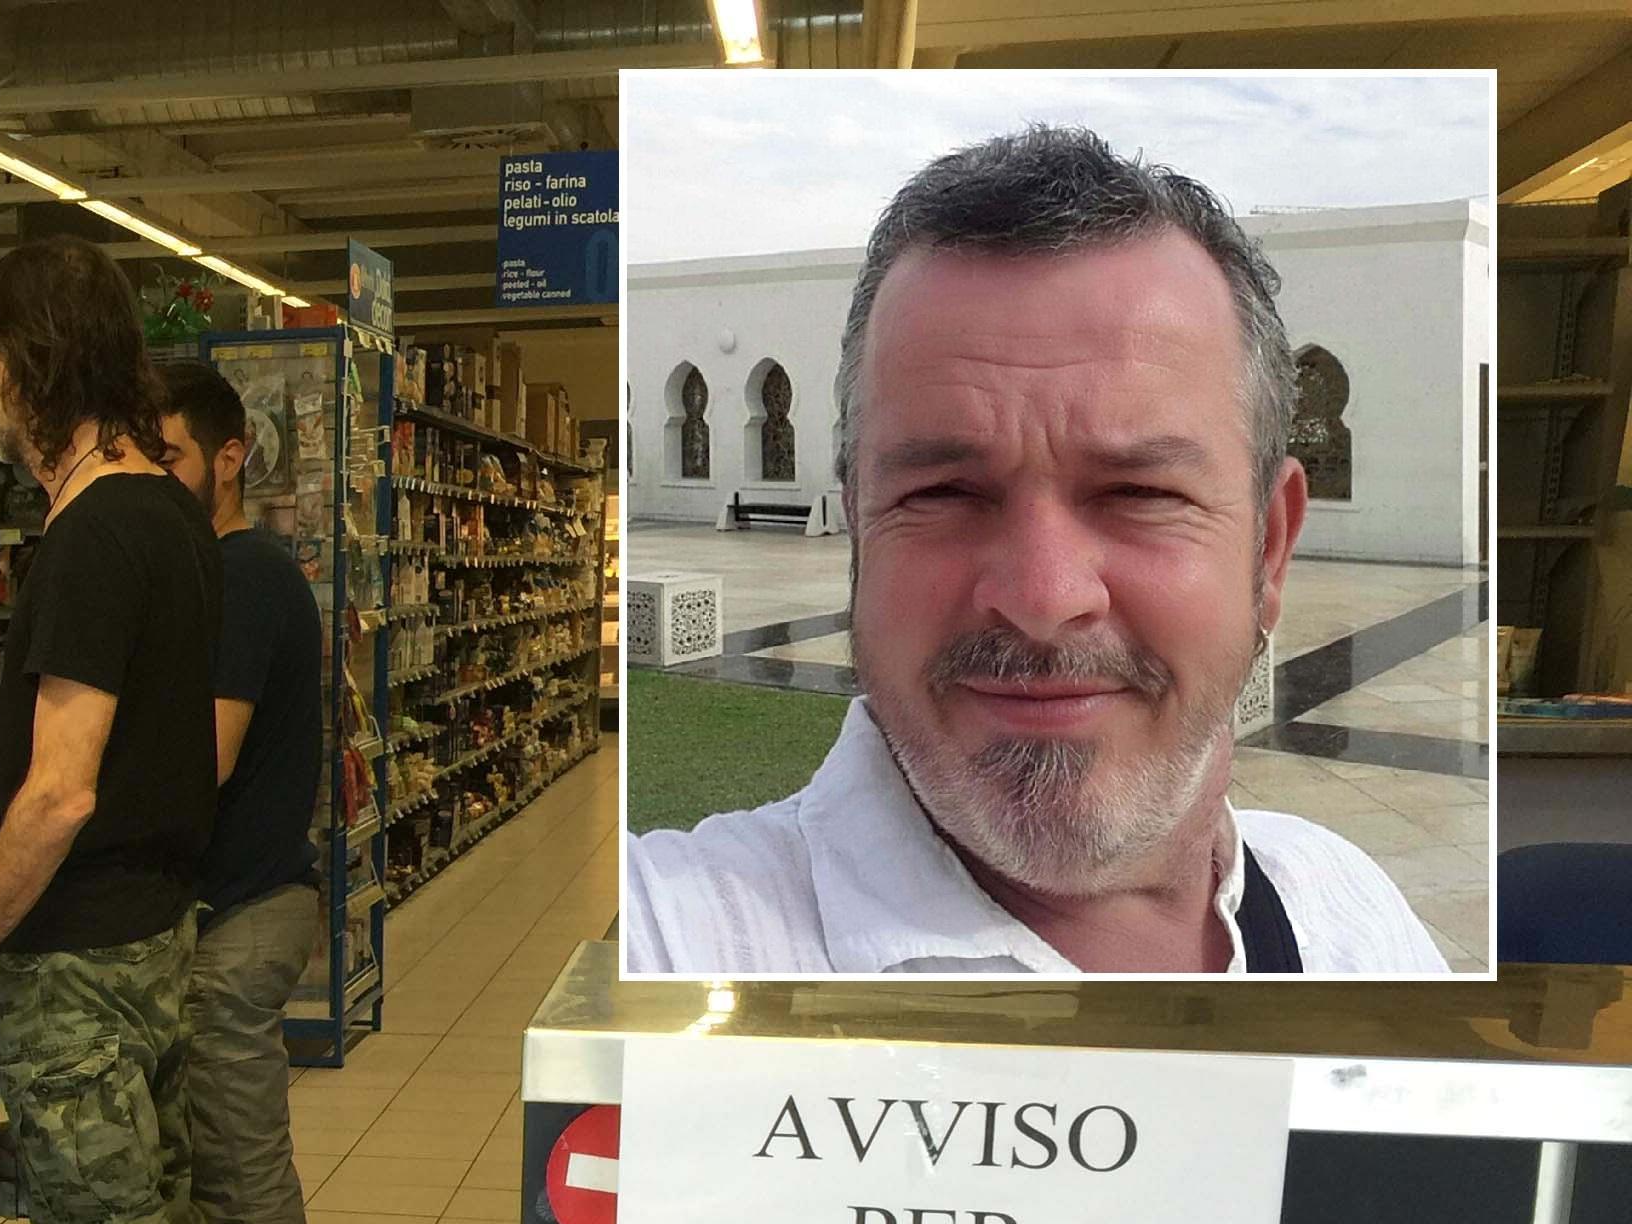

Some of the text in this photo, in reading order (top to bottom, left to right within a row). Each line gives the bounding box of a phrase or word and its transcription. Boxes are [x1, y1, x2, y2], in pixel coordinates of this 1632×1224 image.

[505, 160, 543, 177] pasta
[504, 178, 531, 192] riso
[546, 172, 586, 190] farina
[504, 194, 542, 211] pelati
[552, 193, 577, 207] olio
[504, 208, 619, 230] legumi in scatola
[753, 1094, 1139, 1173] AVVISO
